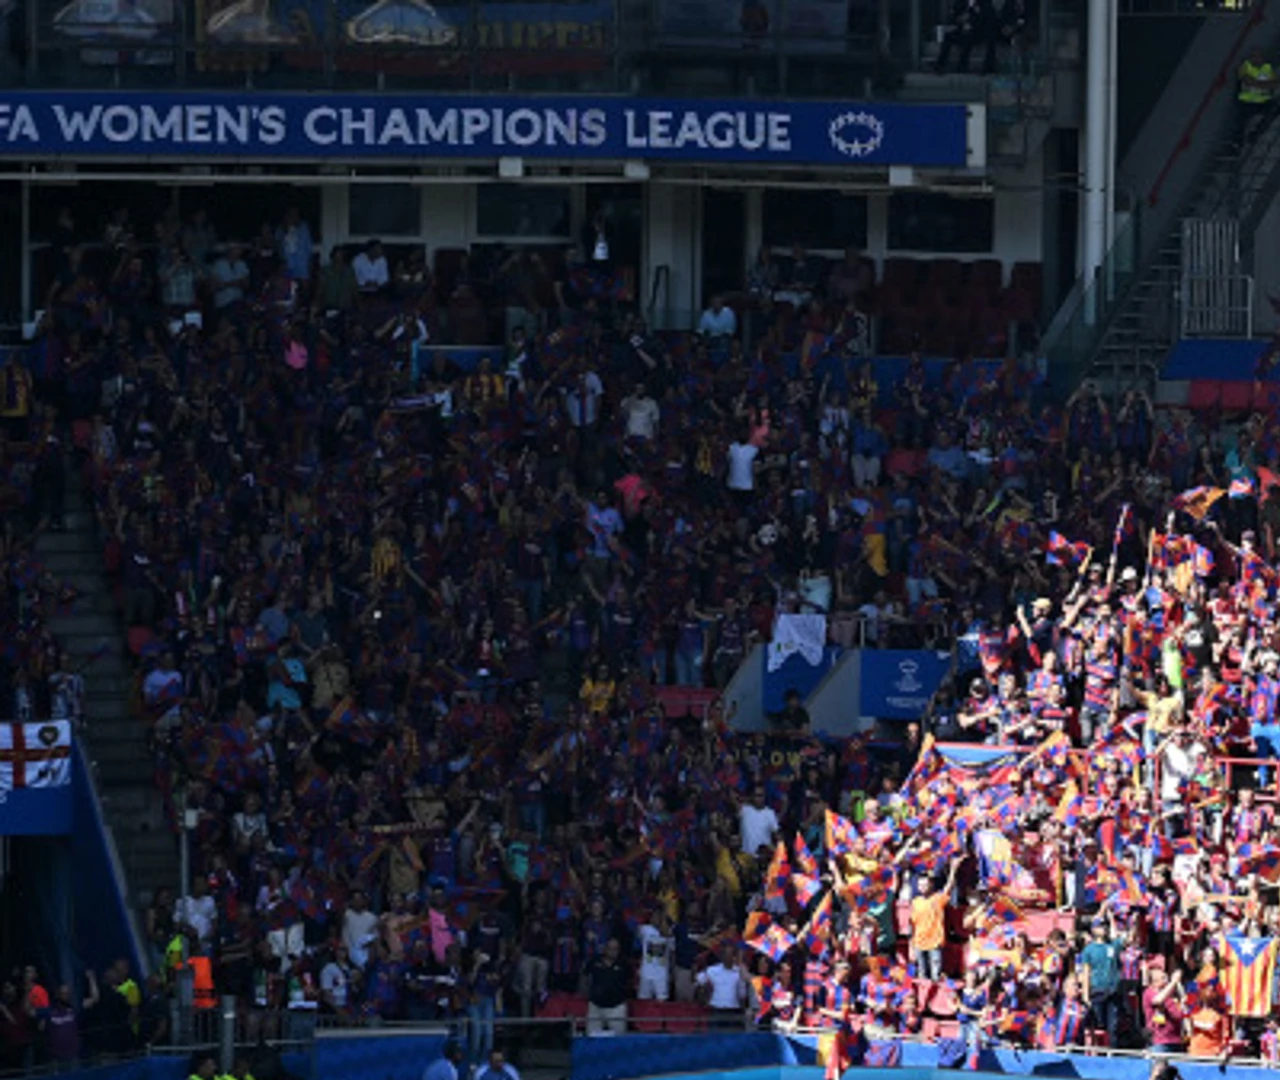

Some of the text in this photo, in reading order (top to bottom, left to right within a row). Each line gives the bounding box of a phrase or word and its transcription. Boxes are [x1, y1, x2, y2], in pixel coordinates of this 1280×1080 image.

[52, 105, 287, 143] WOMEN'S
[303, 106, 607, 145] CHAMPIONS
[624, 109, 792, 151] LEAGUE
